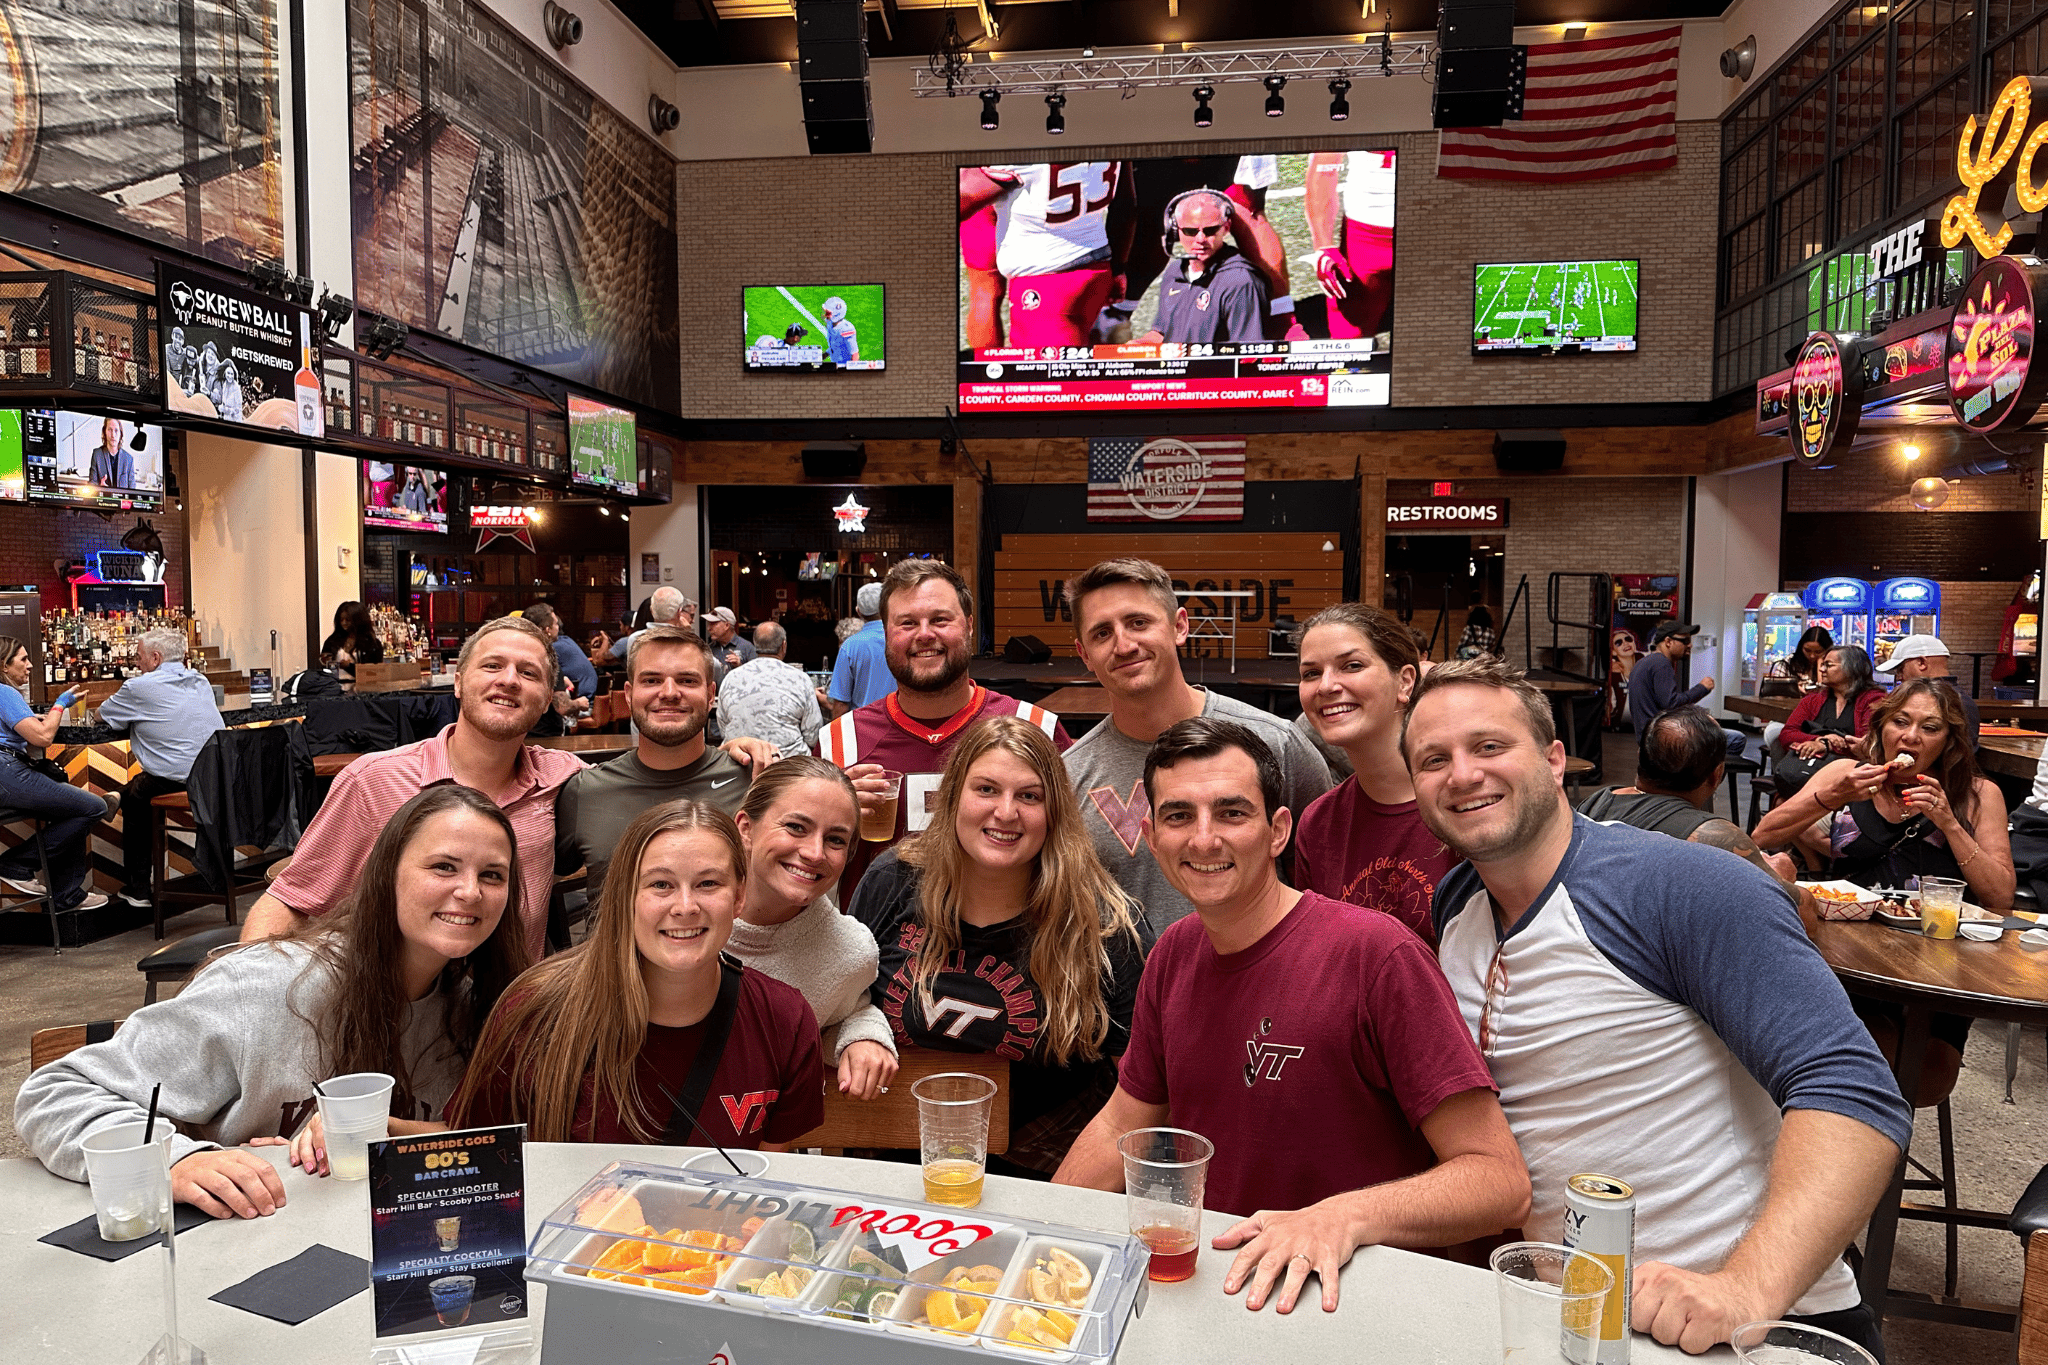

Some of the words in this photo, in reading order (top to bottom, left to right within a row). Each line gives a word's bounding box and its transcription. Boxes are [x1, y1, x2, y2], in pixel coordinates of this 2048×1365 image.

[1870, 218, 1926, 282] THE
[194, 288, 293, 335] SKREWBALL
[195, 312, 228, 329] PEANUT
[229, 321, 259, 339] BUTTER
[260, 330, 293, 347] WHISKEY
[1979, 305, 2027, 355] PLAZA
[231, 346, 294, 371] #GETSKREWED
[989, 348, 1024, 356] FLORIDA
[1066, 347, 1090, 359] 24
[1190, 343, 1215, 356] 24
[1990, 340, 2019, 370] SOL
[1257, 363, 1290, 371] TONIGHT
[1005, 385, 1029, 393] STORM
[1029, 384, 1062, 392] WARNING
[1131, 382, 1166, 391] NEWPORT
[1166, 382, 1187, 390] NEWS
[965, 395, 1005, 405] COUNTY,
[1005, 394, 1043, 404] CAMDEN
[1043, 393, 1084, 404] COUNTY,
[1084, 392, 1125, 403] CHOWAN
[1126, 392, 1167, 402] COUNTY,
[1167, 391, 1220, 401] CURRITUCK
[1220, 390, 1262, 400] COUNTY,
[1262, 389, 1288, 399] DARE
[1118, 460, 1214, 492] WATERSIDE
[1145, 483, 1190, 499] DISTRICT
[474, 516, 526, 526] NORFOLK
[1387, 505, 1498, 522] RESTROOMS
[102, 555, 141, 565] WICKED
[102, 565, 140, 578] TUNA
[1039, 579, 1295, 623] WRSIDE
[927, 733, 943, 744] VT
[1374, 856, 1397, 871] Old
[1398, 858, 1429, 885] North
[920, 991, 1004, 1039] VT
[1246, 1040, 1306, 1081] VT
[719, 1089, 780, 1136] VT
[397, 1138, 464, 1154] WATERSIDE
[464, 1134, 497, 1147] GOES
[424, 1151, 470, 1169] 80'S
[414, 1171, 439, 1182] BAR
[440, 1166, 481, 1179] CRAWL
[397, 1188, 450, 1202] SPECIALTY
[452, 1182, 499, 1196] SHOOTER
[376, 1206, 399, 1215] Starr
[400, 1203, 415, 1212] Hill
[417, 1202, 433, 1210] Bar
[439, 1196, 473, 1208] Scooby
[474, 1195, 493, 1203] Doo
[494, 1190, 521, 1201] Snack
[687, 1188, 834, 1223] LIGHT
[828, 1205, 994, 1256] Coors
[399, 1255, 451, 1270] SPECIALTY
[453, 1249, 503, 1261] COCKTAIL
[386, 1273, 409, 1282] Starr
[410, 1270, 425, 1279] Hill
[427, 1268, 443, 1276] Bar
[449, 1264, 469, 1274] Stay
[470, 1258, 514, 1270] Excellent!
